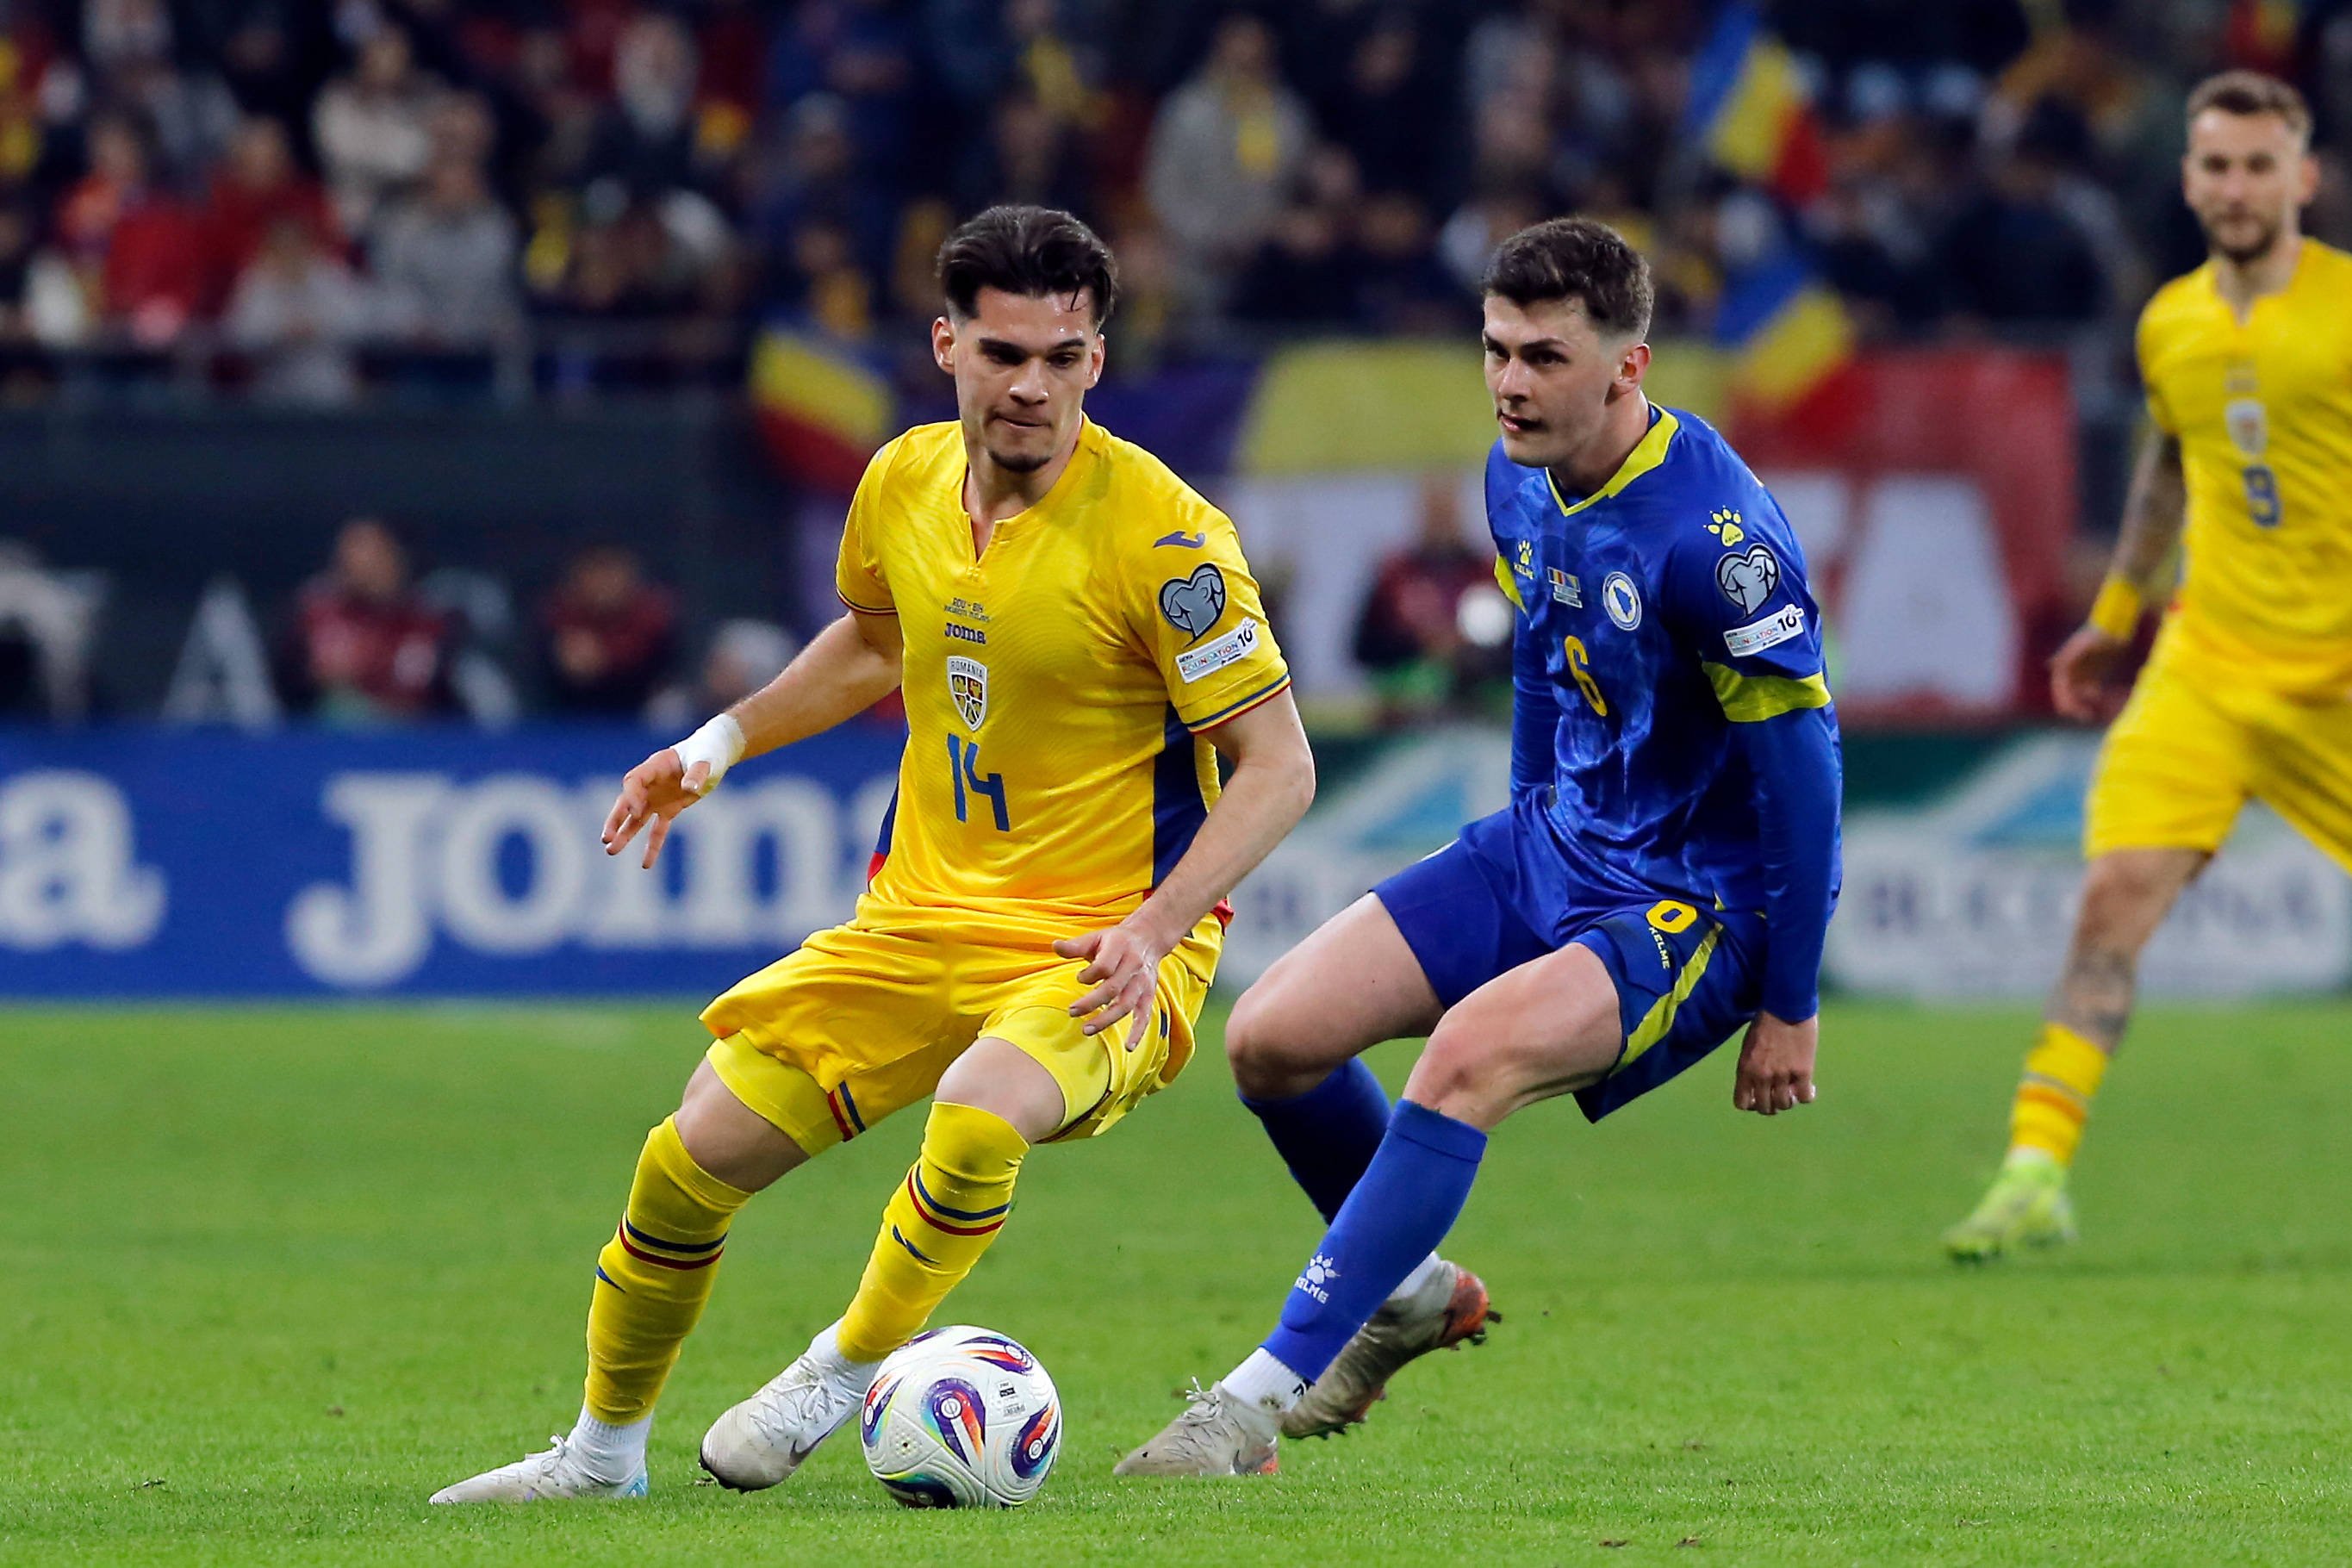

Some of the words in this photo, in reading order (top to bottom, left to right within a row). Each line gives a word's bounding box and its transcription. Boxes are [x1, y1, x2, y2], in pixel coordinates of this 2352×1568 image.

[2242, 464, 2282, 528] 9
[1182, 643, 1238, 673] FOUNDATION
[1564, 635, 1608, 717] 6
[948, 733, 1010, 832] 14
[286, 768, 893, 988] Jom
[1648, 927, 1671, 969] KELME
